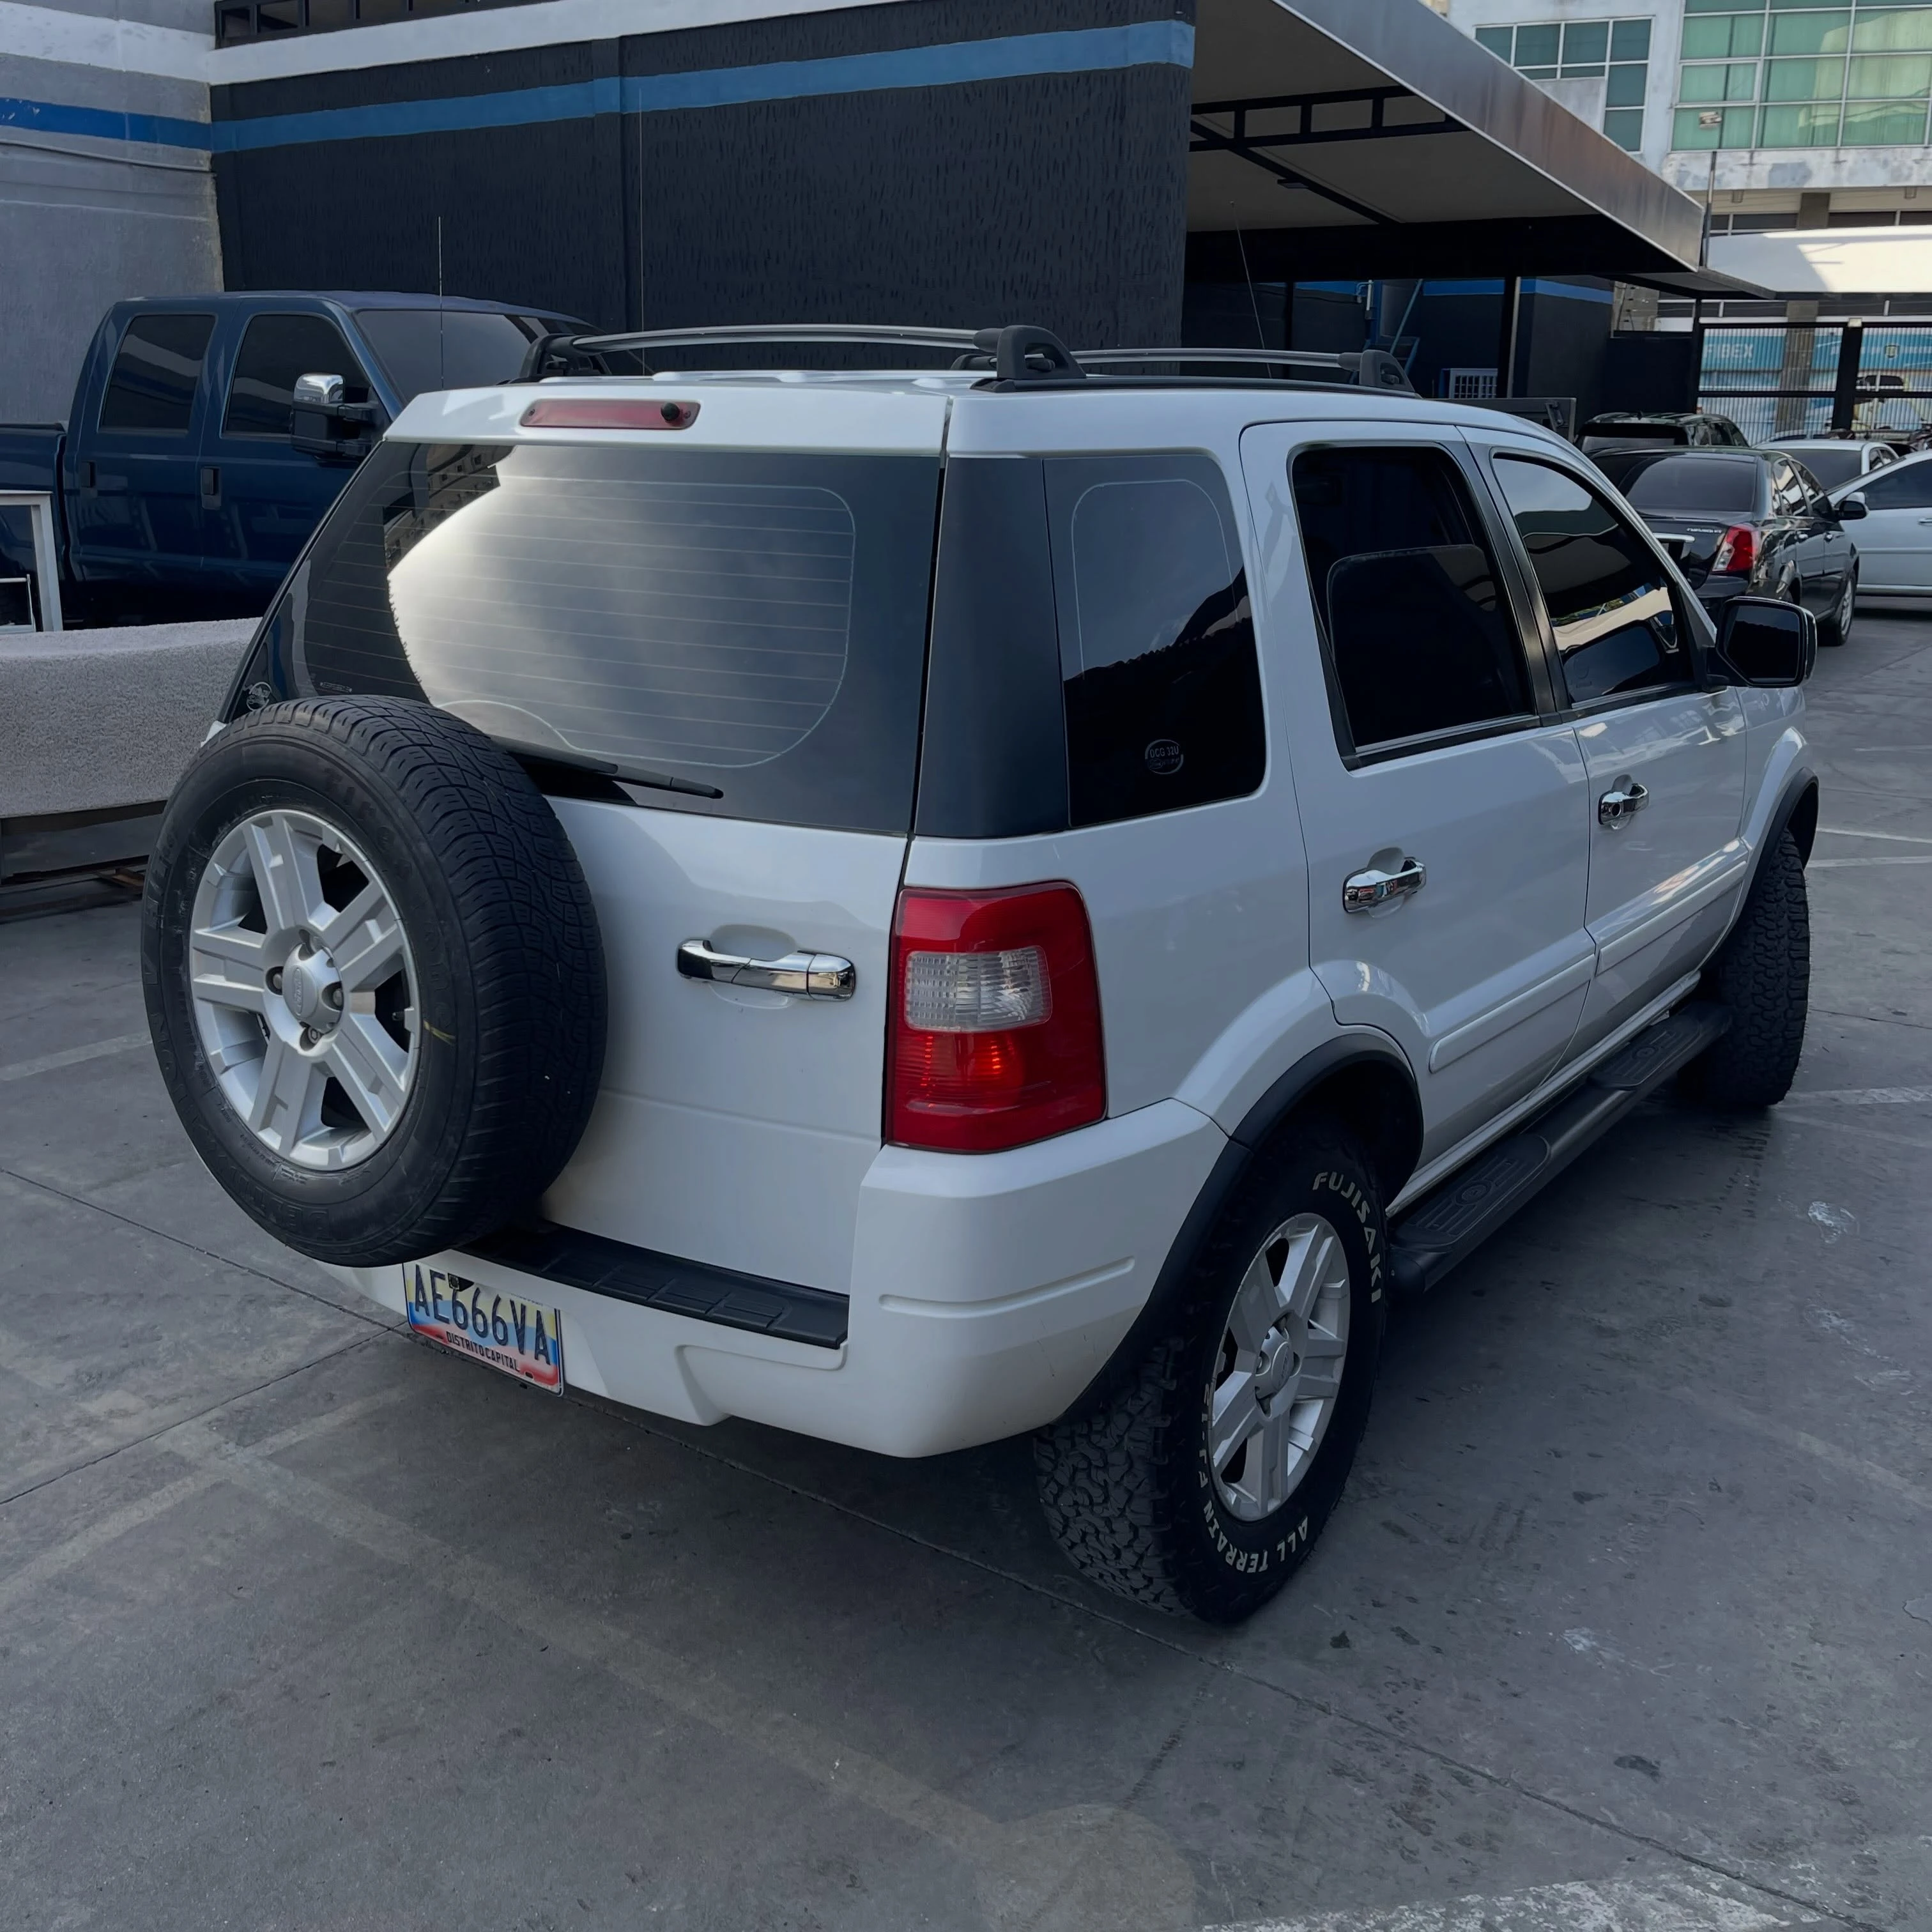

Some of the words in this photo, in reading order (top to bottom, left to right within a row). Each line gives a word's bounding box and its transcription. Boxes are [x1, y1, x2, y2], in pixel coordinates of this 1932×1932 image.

[1312, 1171, 1382, 1303] FUJISAKI
[415, 1264, 551, 1365] AE666VA
[446, 1331, 484, 1356] DISTRITO
[485, 1346, 520, 1372] CAPITAL
[1203, 1500, 1269, 1574] TERRAIN
[1276, 1515, 1308, 1562] ALL
